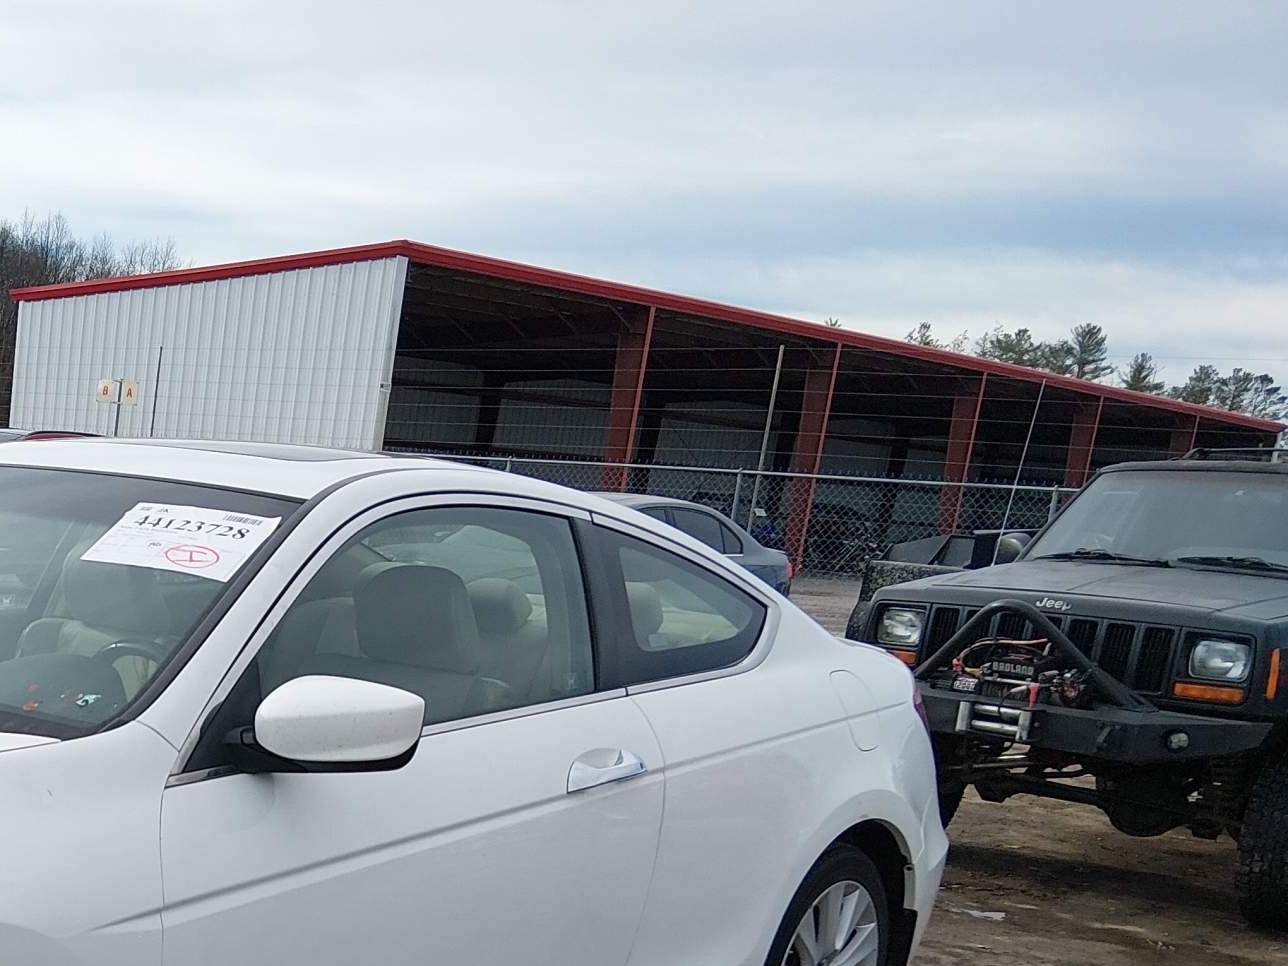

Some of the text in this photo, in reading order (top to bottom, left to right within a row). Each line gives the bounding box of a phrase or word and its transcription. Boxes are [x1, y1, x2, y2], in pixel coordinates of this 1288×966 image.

[102, 385, 109, 396] B
[126, 387, 133, 398] A
[133, 515, 250, 540] 44123728
[1035, 597, 1072, 611] Jeep
